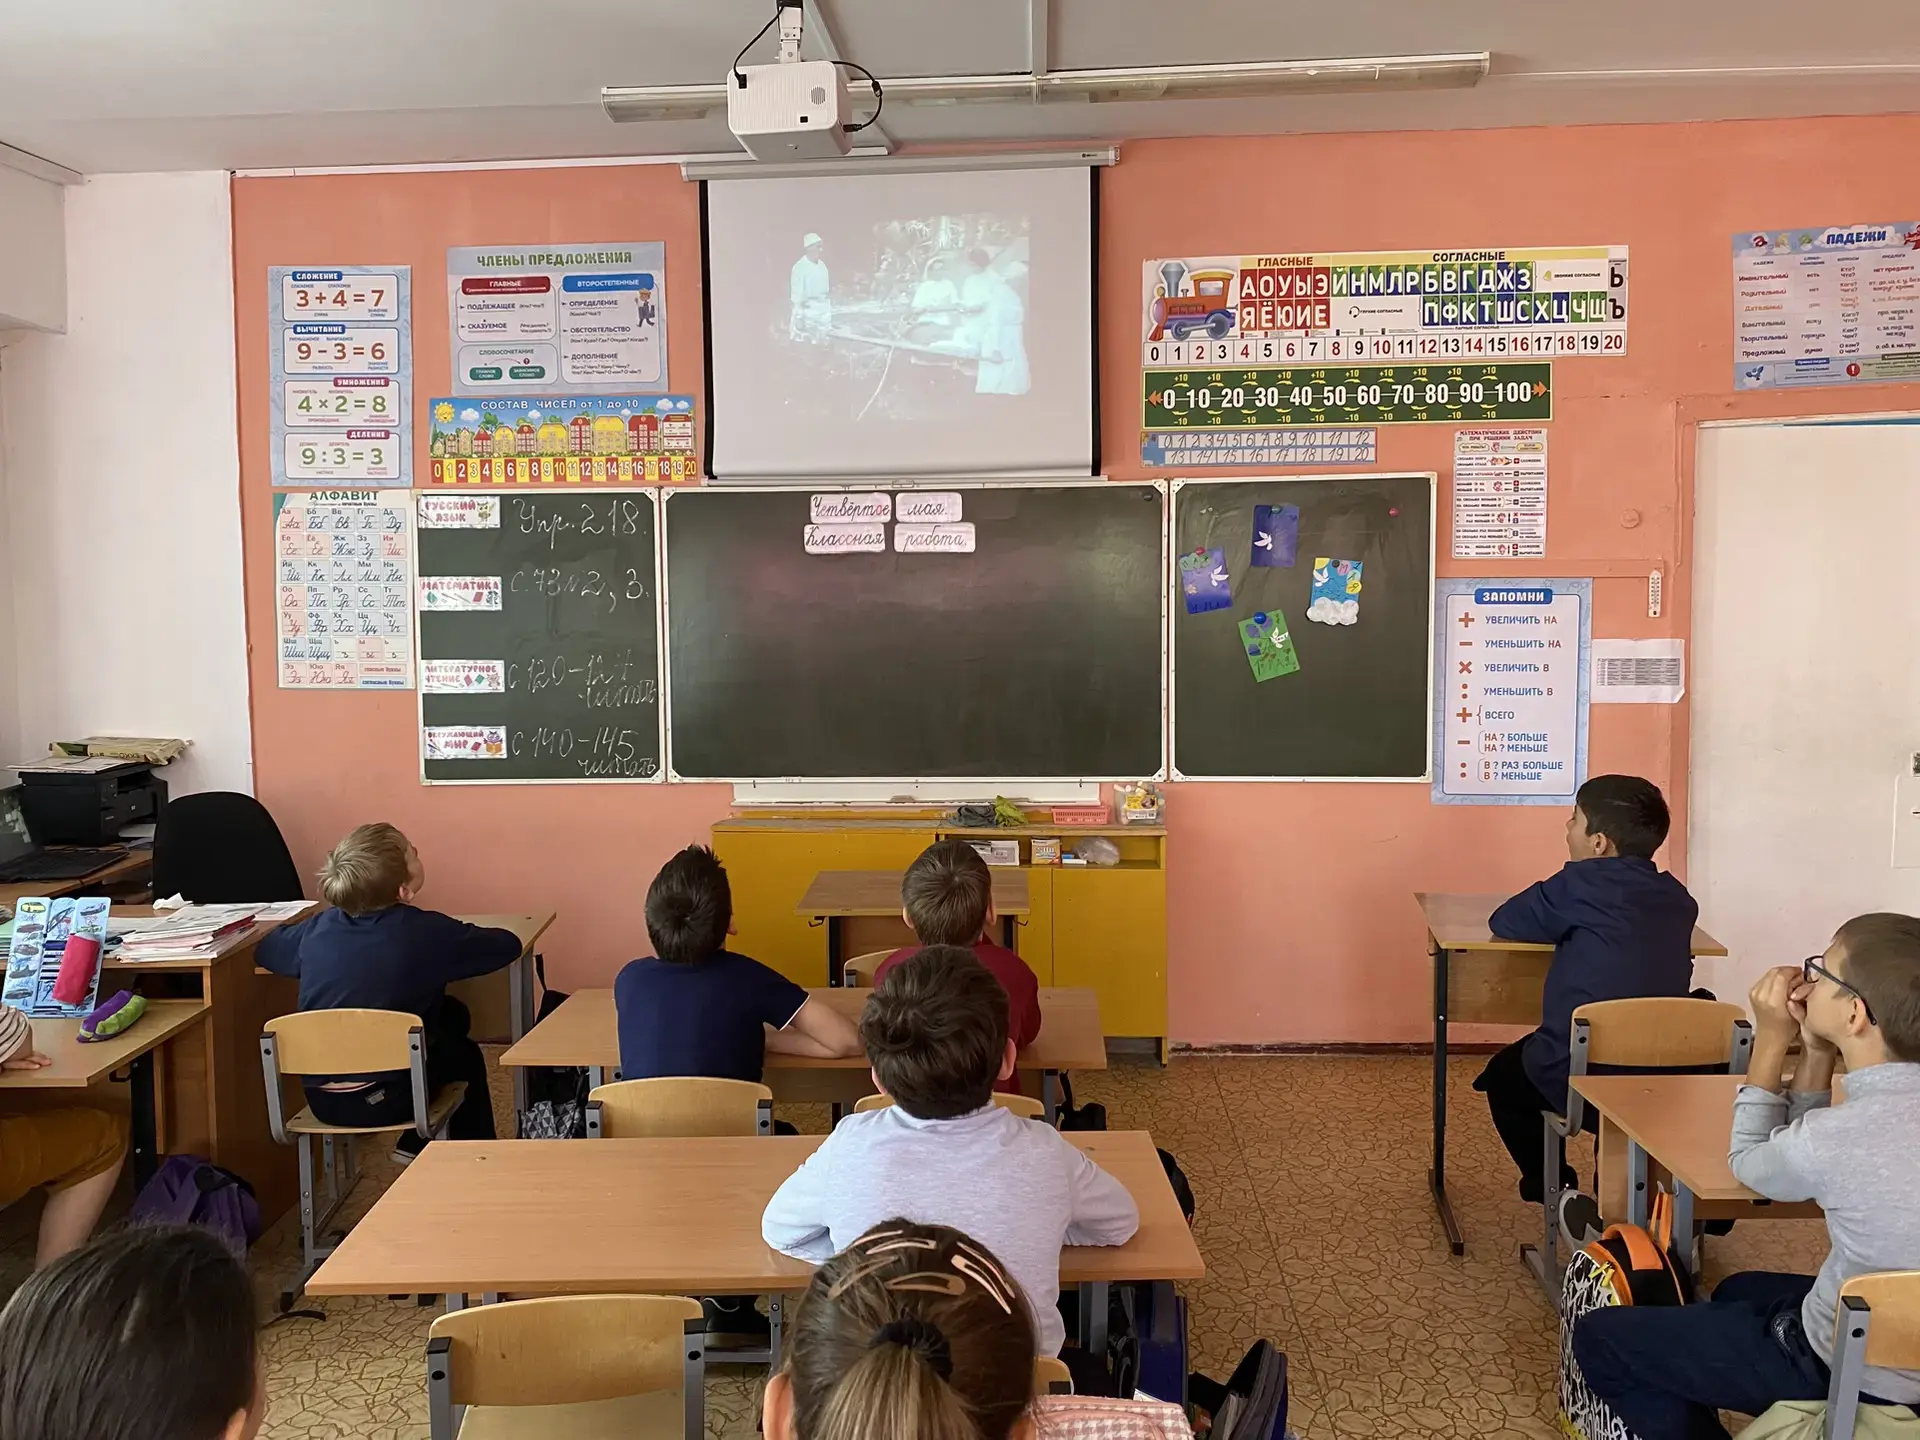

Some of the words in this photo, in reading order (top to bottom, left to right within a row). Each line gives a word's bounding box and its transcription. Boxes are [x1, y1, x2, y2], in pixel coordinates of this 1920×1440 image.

[1825, 230, 1887, 245] ПАДЕЖИ
[477, 254, 524, 267] ЧЛЕНЫ
[528, 252, 632, 267] ПРЕДЛОЖЕНИЯ
[1257, 256, 1314, 267] ГЛАСНЫЕ
[1433, 251, 1506, 262] СОГЛАСНЫЕ
[296, 272, 339, 280] СЛОЖЕНИЕ
[577, 279, 639, 288] ВТОРОСТЕПЕННЫЕ
[296, 290, 310, 308] 3
[332, 290, 347, 308] 4
[371, 290, 385, 308] 7
[297, 343, 311, 360] 9
[334, 343, 347, 360] 3
[371, 343, 385, 360] 6
[1150, 346, 1160, 361] 0
[1174, 346, 1181, 360] 1
[1195, 345, 1205, 360] 2
[1218, 344, 1227, 359] 3
[1240, 344, 1250, 358] 4
[1263, 343, 1273, 358] 5
[1286, 342, 1295, 357] 6
[1309, 342, 1318, 356] 7
[1332, 341, 1341, 356] 8
[1354, 340, 1364, 355] 9
[1373, 340, 1391, 355] 10
[1397, 340, 1414, 354] 11
[1419, 339, 1437, 354] 12
[1442, 338, 1460, 353] 13
[1465, 337, 1483, 352] 14
[1488, 337, 1506, 352] 15
[1511, 336, 1529, 351] 16
[1534, 336, 1552, 351] 17
[1557, 335, 1575, 350] 18
[1580, 335, 1599, 350] 19
[1604, 334, 1622, 349] 20
[1163, 389, 1176, 410] 0
[1186, 389, 1211, 409] 10
[1221, 388, 1244, 408] 20
[1255, 387, 1279, 407] 30
[1289, 386, 1313, 406] 40
[1323, 385, 1347, 406] 50
[1357, 385, 1381, 405] 60
[1392, 384, 1415, 405] 70
[1425, 383, 1449, 404] 80
[1459, 383, 1483, 403] 90
[1494, 382, 1532, 403] 100
[298, 395, 312, 412] 4
[335, 395, 347, 412] 2
[372, 395, 386, 412] 8
[481, 401, 528, 409] СОСТАВ
[536, 400, 576, 408] ЧИСЕЛ
[597, 400, 602, 408] 1
[607, 401, 621, 409] до
[626, 399, 638, 408] 10
[302, 448, 316, 465] 9
[333, 448, 346, 465] 3
[371, 448, 383, 465] 3
[434, 463, 441, 478] 0
[447, 463, 453, 477] 1
[458, 463, 466, 477] 2
[470, 462, 478, 477] 3
[482, 463, 490, 476] 4
[495, 462, 502, 476] 5
[507, 462, 514, 476] 6
[519, 462, 527, 476] 7
[531, 462, 539, 476] 8
[543, 462, 551, 476] 9
[554, 461, 565, 476] 10
[567, 461, 579, 476] 11
[580, 461, 592, 475] 12
[593, 461, 605, 475] 13
[606, 461, 618, 475] 14
[619, 461, 630, 475] 15
[632, 461, 644, 475] 16
[645, 460, 657, 475] 17
[659, 460, 670, 475] 18
[672, 460, 683, 475] 19
[685, 460, 697, 475] 20
[309, 491, 379, 501] АЛФАВИТ
[425, 501, 476, 511] РУССКИЙ
[812, 496, 890, 522] Четвёртое
[435, 513, 466, 523] ЯЗЫК
[805, 525, 885, 547] Классная
[421, 580, 499, 591] МАТЕМАТИКА
[1482, 591, 1545, 602] ЗАПОМНИ
[1485, 615, 1540, 625] УВЕЛИЧИТЬ
[1543, 615, 1557, 625] НА
[1485, 639, 1545, 649] УМЕНЬШИТЬ
[1548, 639, 1561, 648] НА
[424, 665, 497, 674] ЛИТЕРАТУРНОЕ
[1484, 663, 1540, 673] УВЕЛИЧИТЬ
[1543, 664, 1550, 672] В
[425, 675, 461, 683] ЧТЕНИЕ
[1484, 687, 1543, 697] УМЕНЬШИТЬ
[1546, 688, 1553, 696] В
[1485, 711, 1515, 720] ВСЕГО
[427, 729, 484, 739] ОКРУЖАЮЩИЙ
[1484, 733, 1498, 742] НА
[1500, 733, 1505, 742] ?
[1507, 732, 1548, 742] БОЛЬШЕ
[443, 740, 469, 750] МИР
[1484, 744, 1498, 753] НА
[1500, 744, 1505, 753] ?
[1507, 744, 1548, 753] МЕНЬШЕ
[1484, 761, 1491, 770] В
[1493, 761, 1499, 770] ?
[1501, 761, 1520, 770] РАЗ
[1522, 761, 1563, 770] БОЛЬШЕ
[1484, 771, 1491, 780] В
[1493, 772, 1499, 780] ?
[1501, 771, 1542, 780] МЕНЬШЕ
